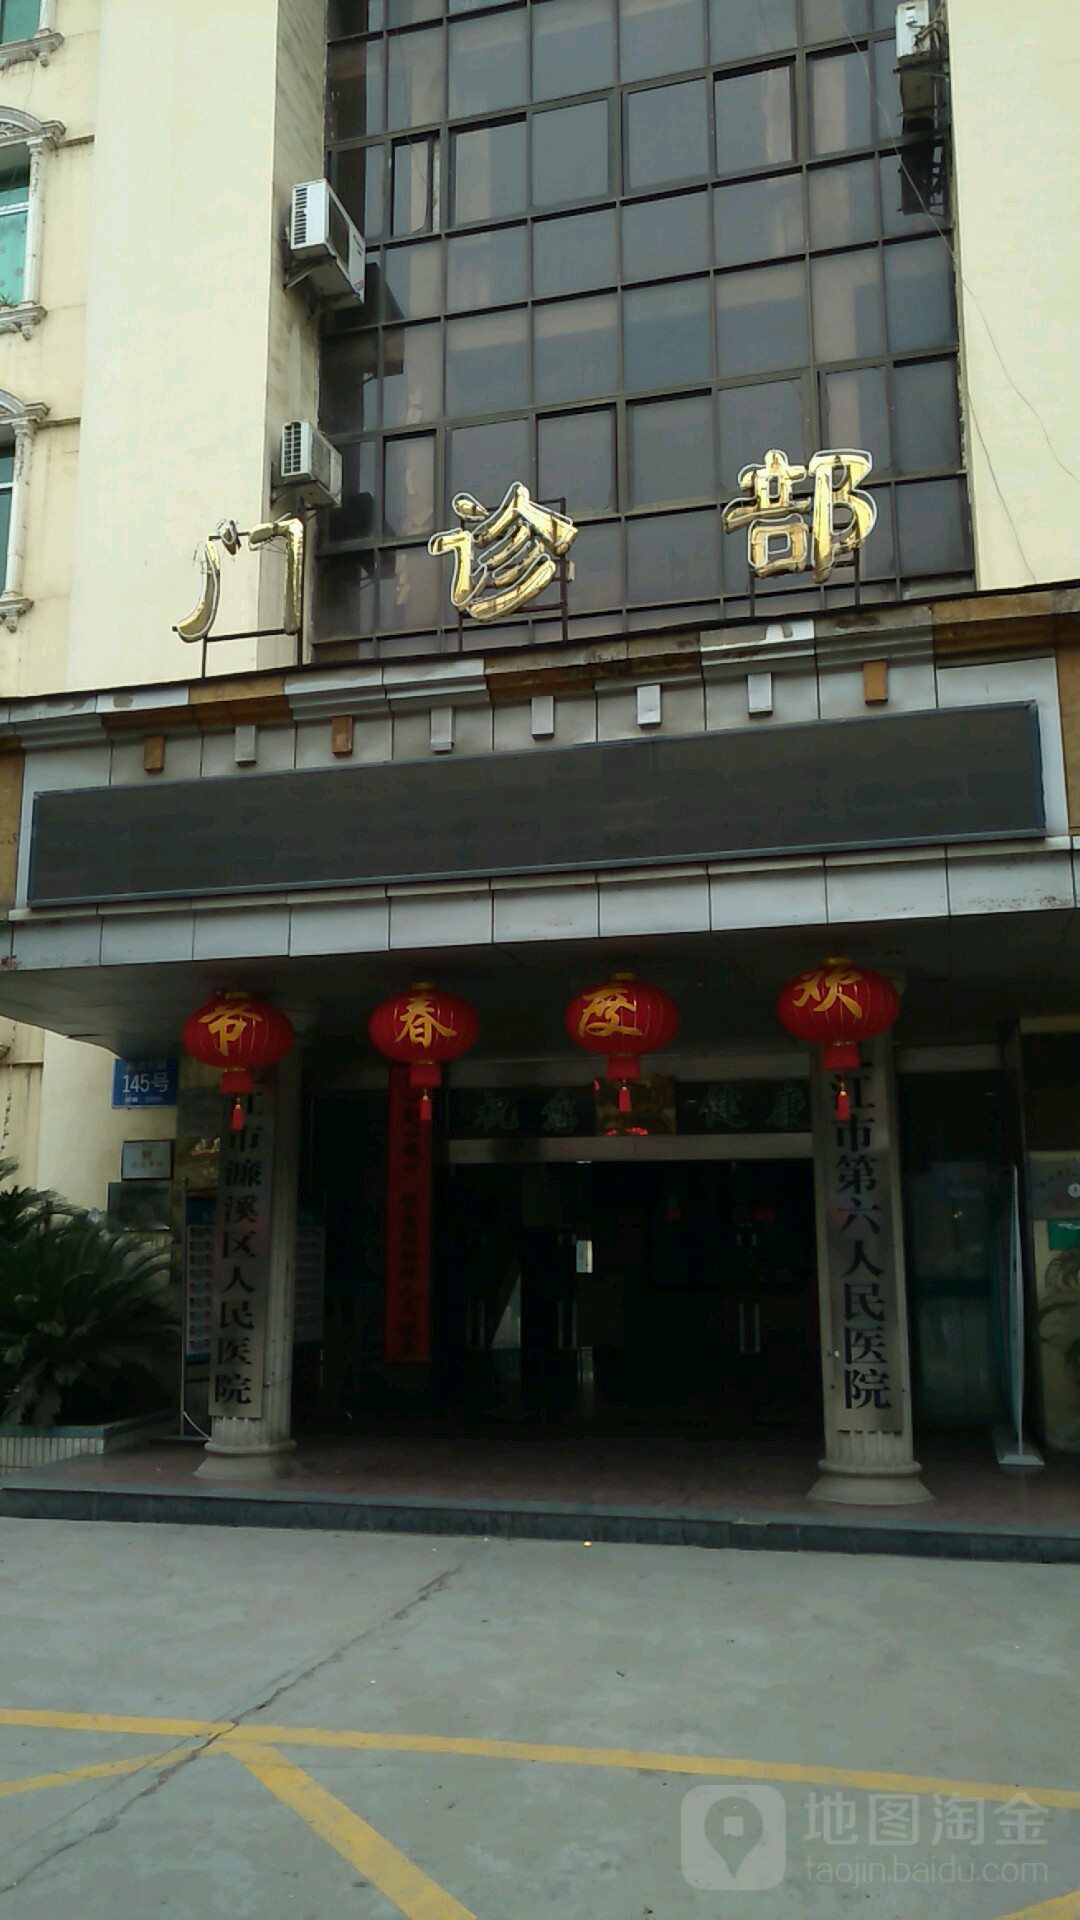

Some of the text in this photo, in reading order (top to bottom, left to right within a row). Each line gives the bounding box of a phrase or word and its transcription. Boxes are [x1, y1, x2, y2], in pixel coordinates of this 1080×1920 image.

[172, 448, 878, 643] 门诊部
[394, 994, 457, 1048] 春
[577, 987, 643, 1039] 度
[791, 967, 864, 1020] 欢
[198, 1001, 263, 1057] 节
[122, 1071, 169, 1093] 145号
[214, 1079, 266, 1405] 市濂溪区人民医院
[829, 1059, 892, 1411] 江市第六人民医院
